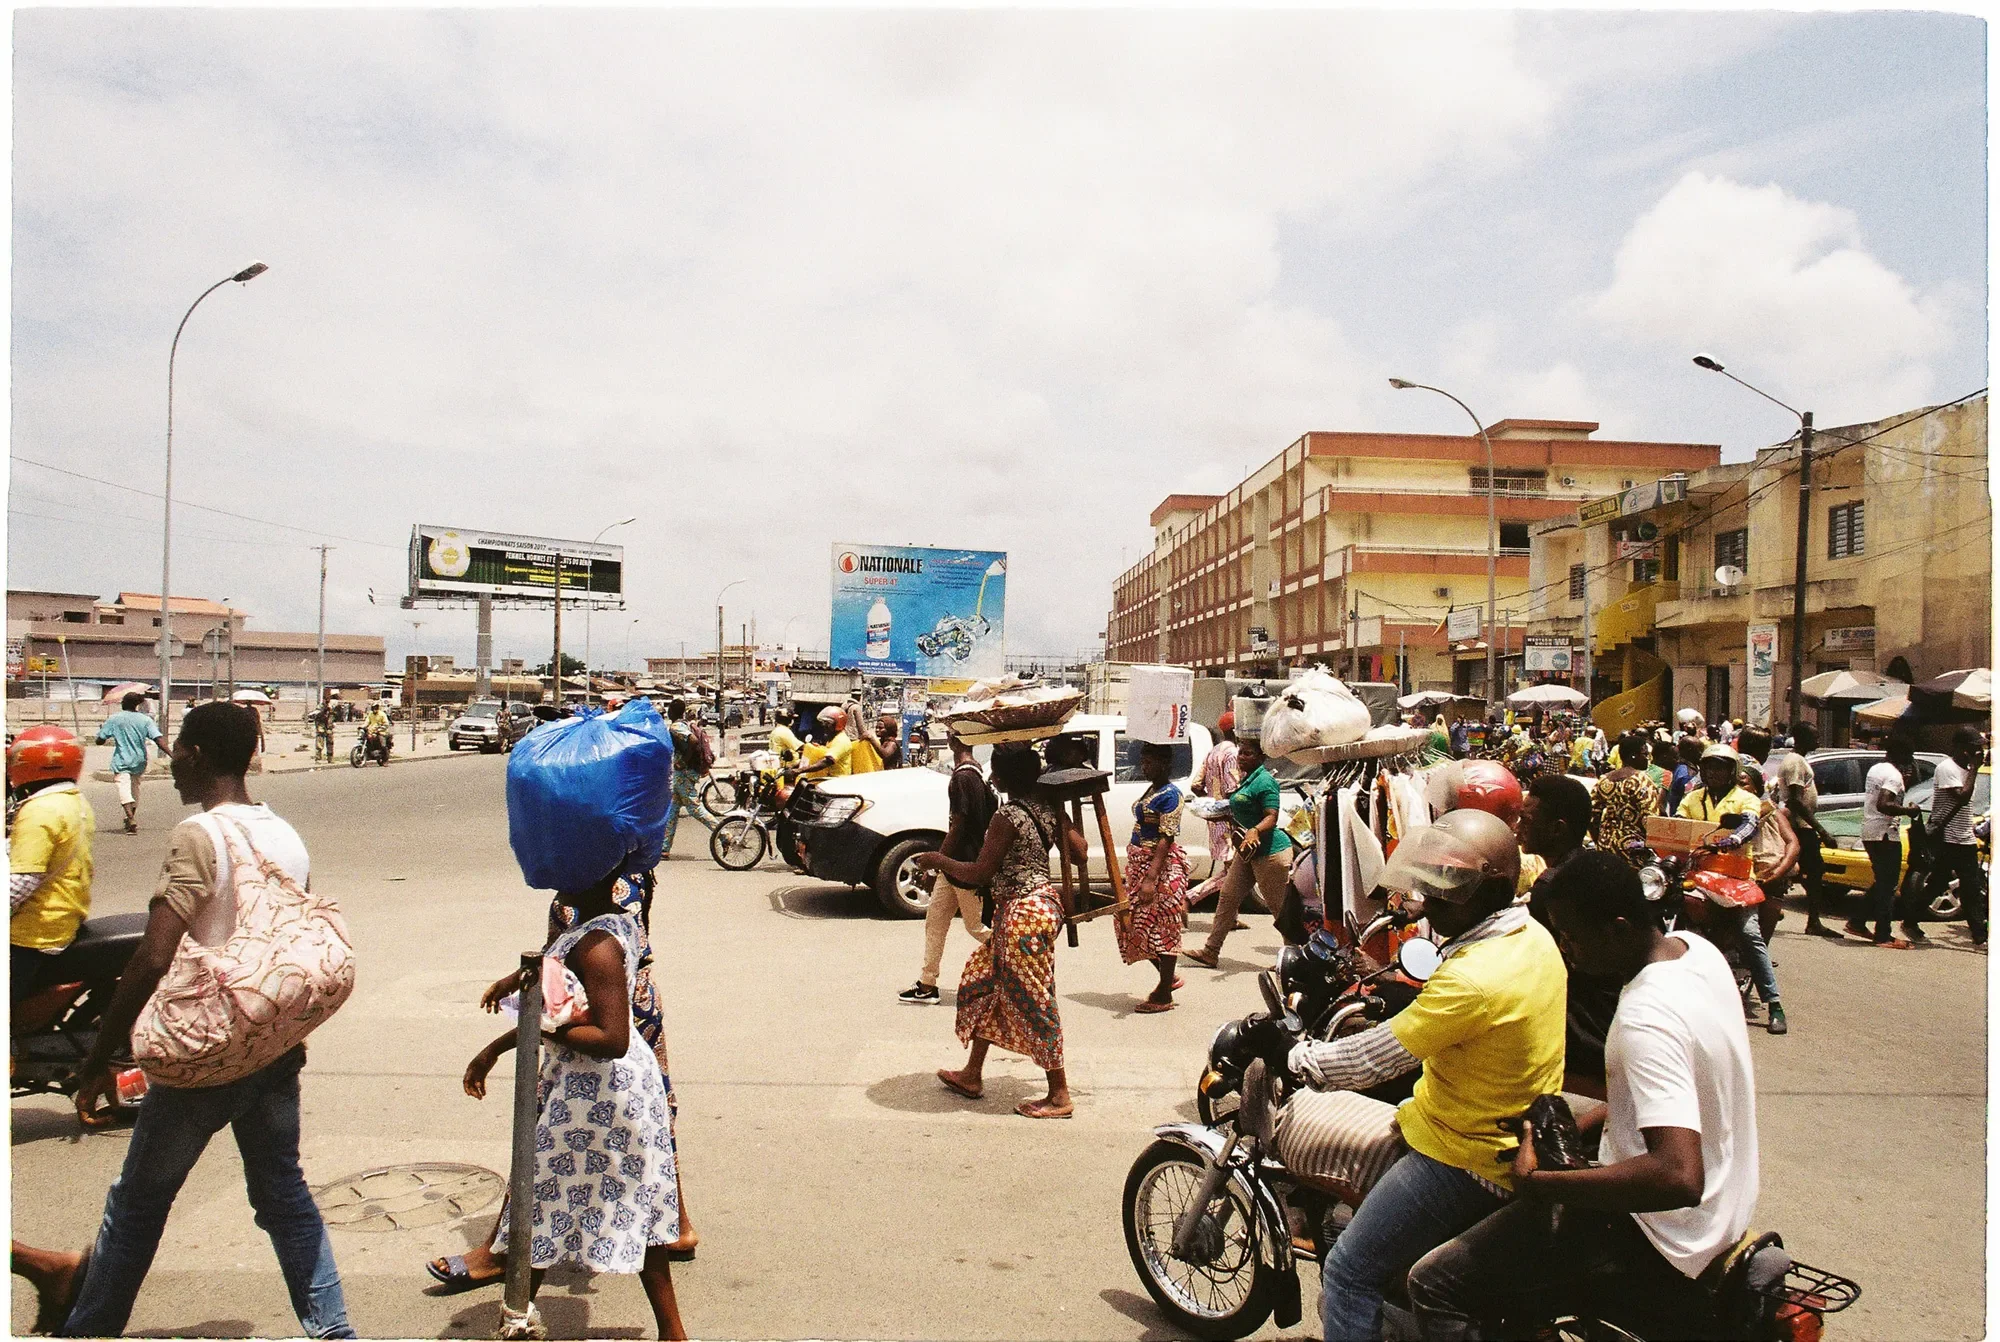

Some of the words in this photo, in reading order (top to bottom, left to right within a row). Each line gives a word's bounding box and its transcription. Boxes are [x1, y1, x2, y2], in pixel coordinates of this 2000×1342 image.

[477, 538, 516, 548] CHAMPIONNATS
[516, 541, 534, 550] SAISON
[860, 555, 923, 574] NATIONALE
[864, 576, 888, 586] SUPER
[890, 578, 898, 586] 4T
